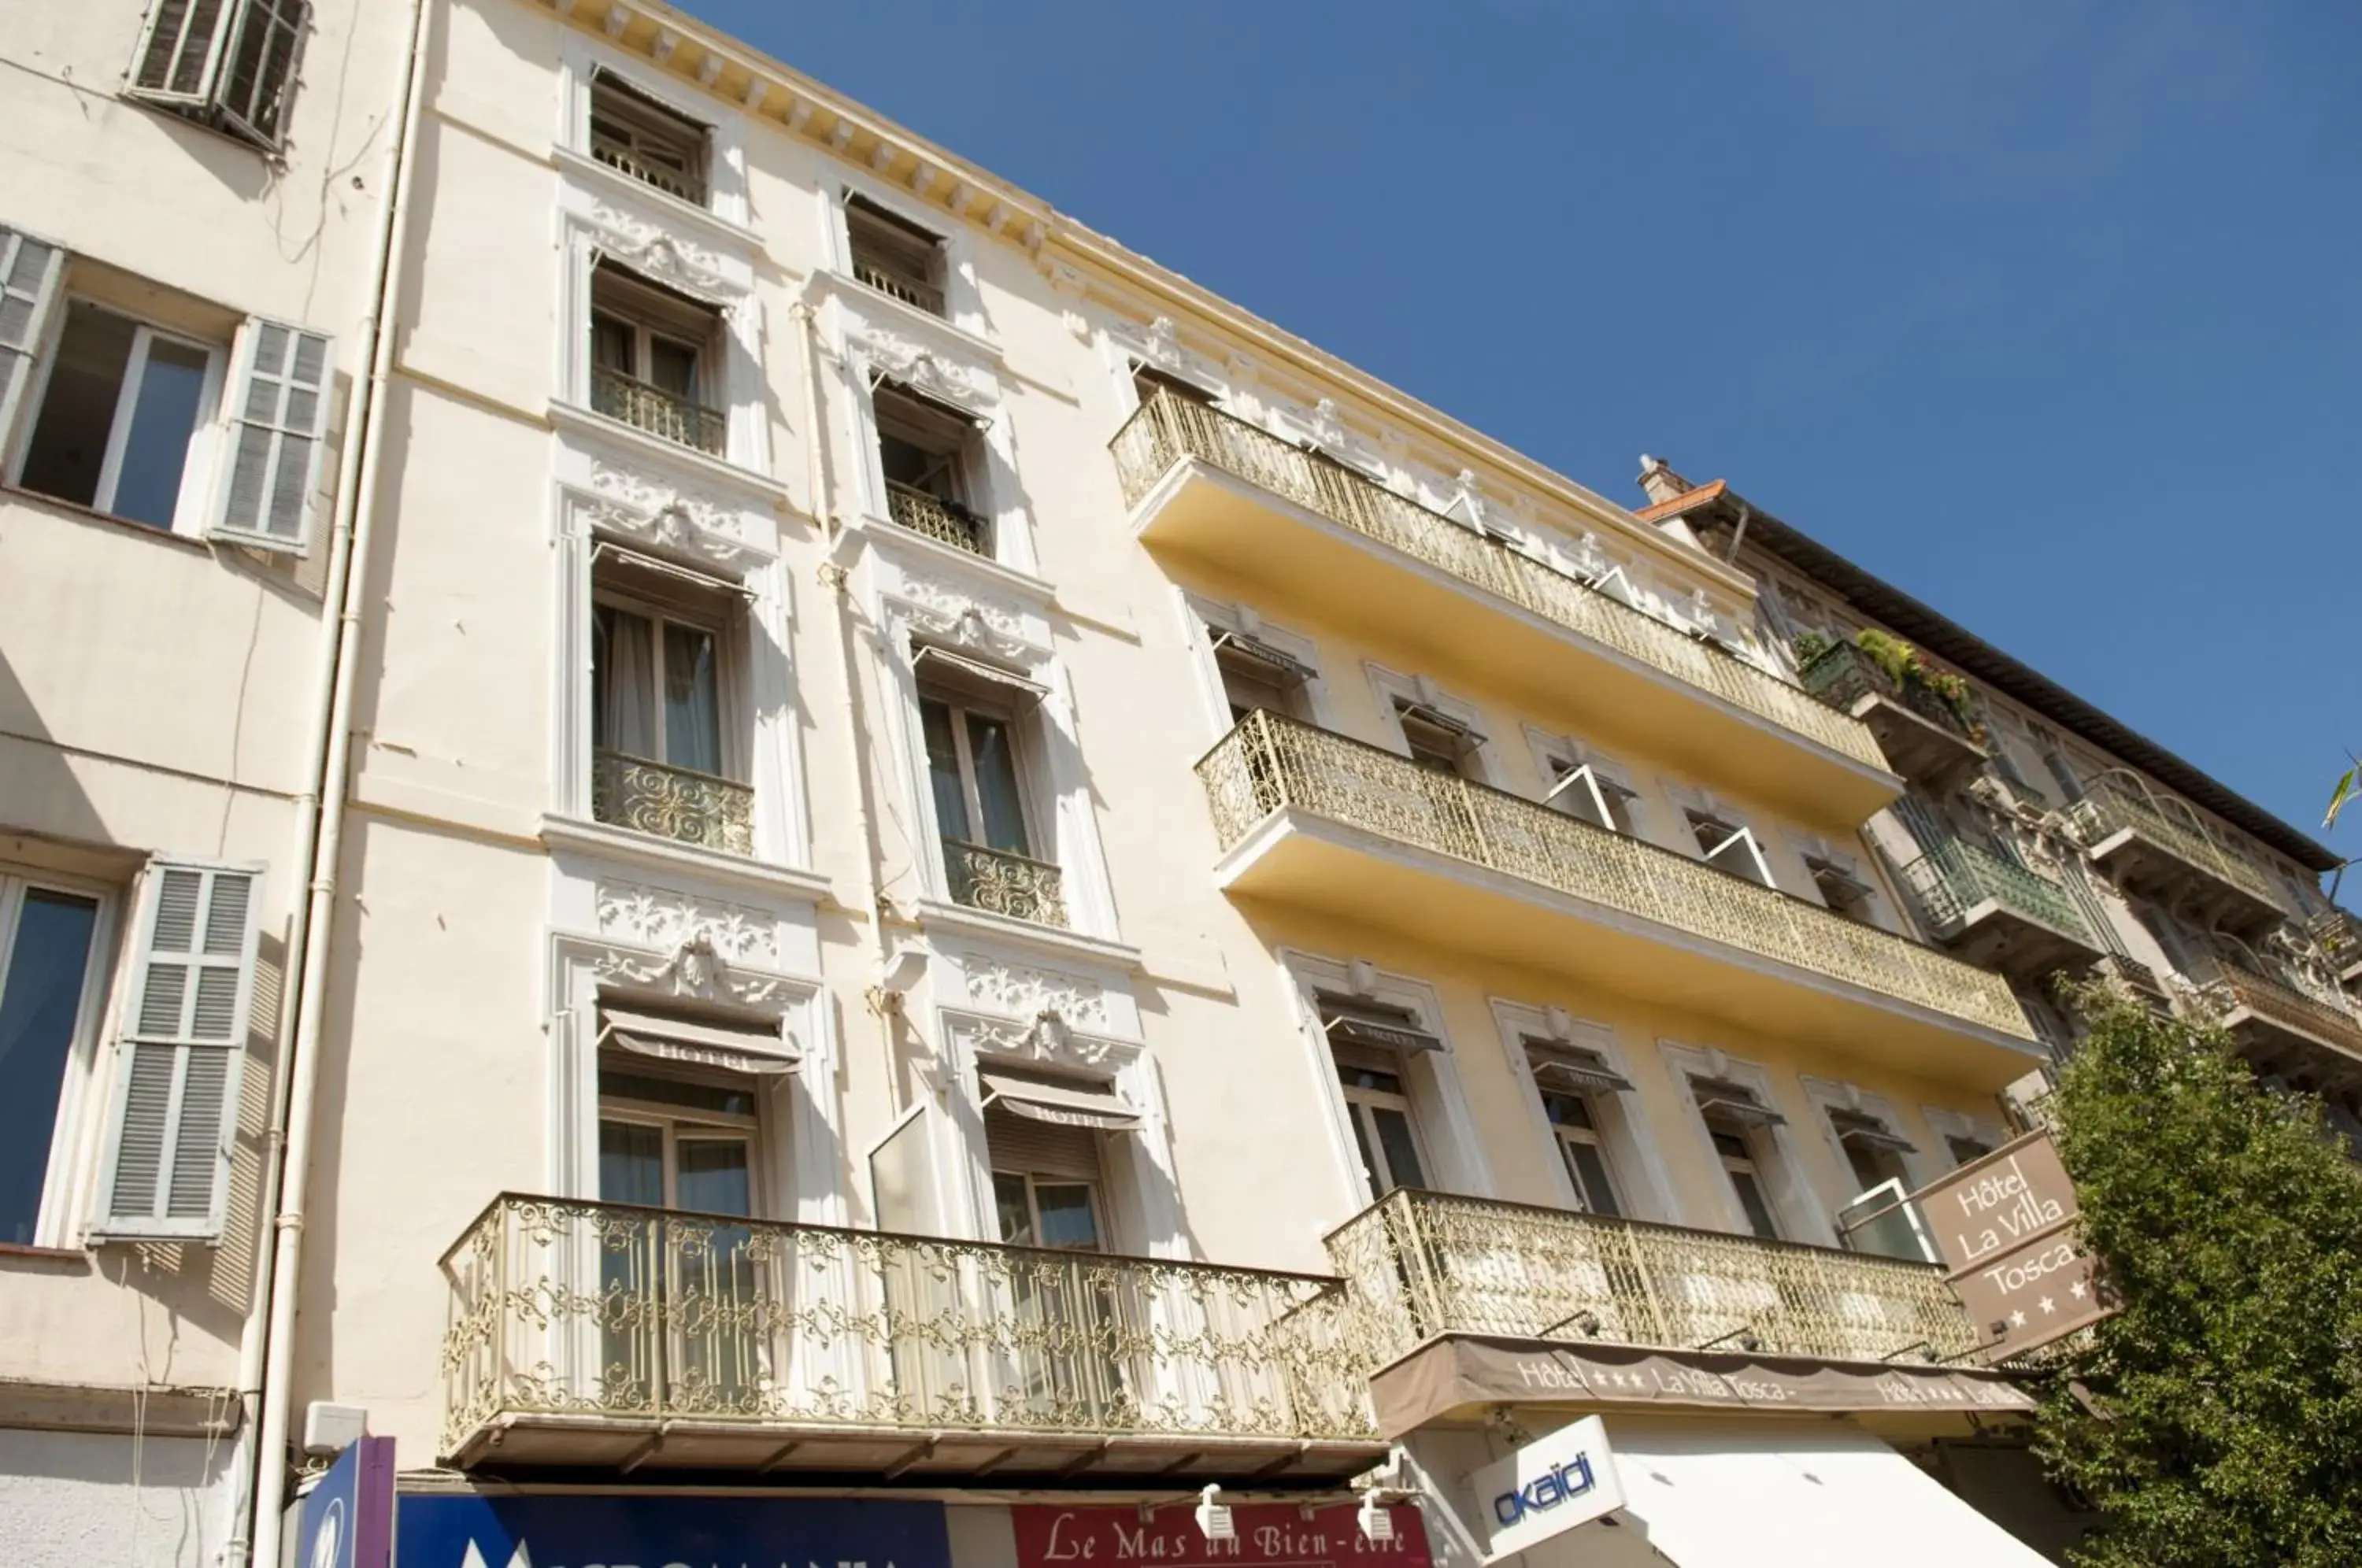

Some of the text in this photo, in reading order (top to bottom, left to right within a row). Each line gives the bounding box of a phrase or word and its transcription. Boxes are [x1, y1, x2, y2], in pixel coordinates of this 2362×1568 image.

[1957, 1155, 2027, 1217] Hôtel
[1958, 1189, 2064, 1260] La Villa
[1984, 1243, 2075, 1295] Tosca
[1516, 1355, 1590, 1389] Hôtel
[1650, 1367, 1686, 1394] La
[1043, 1512, 1096, 1560] Le
[1113, 1522, 1187, 1559] Mas
